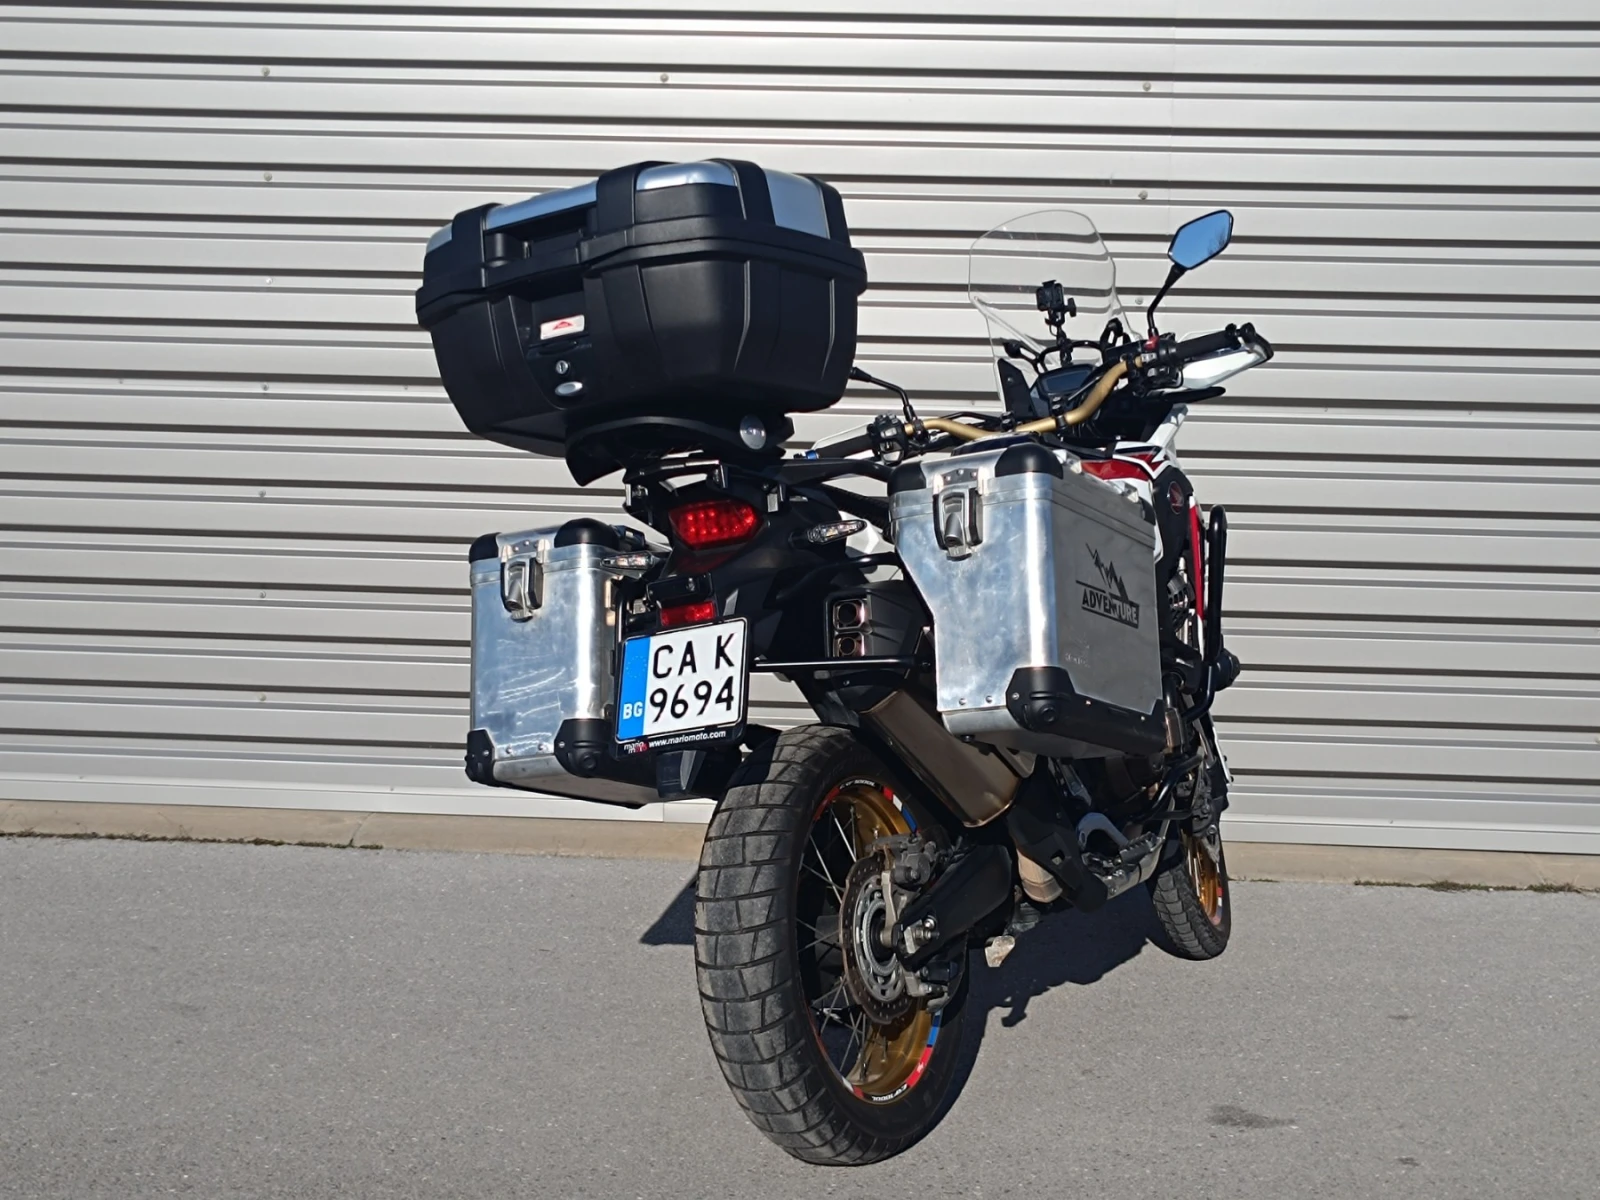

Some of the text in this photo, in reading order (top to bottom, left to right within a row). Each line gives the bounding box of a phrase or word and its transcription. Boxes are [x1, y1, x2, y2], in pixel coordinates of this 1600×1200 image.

[1082, 588, 1138, 624] ADVENTURE
[622, 702, 643, 720] BG
[649, 675, 734, 723] 9694
[648, 731, 726, 748] www.mariomoto.com
